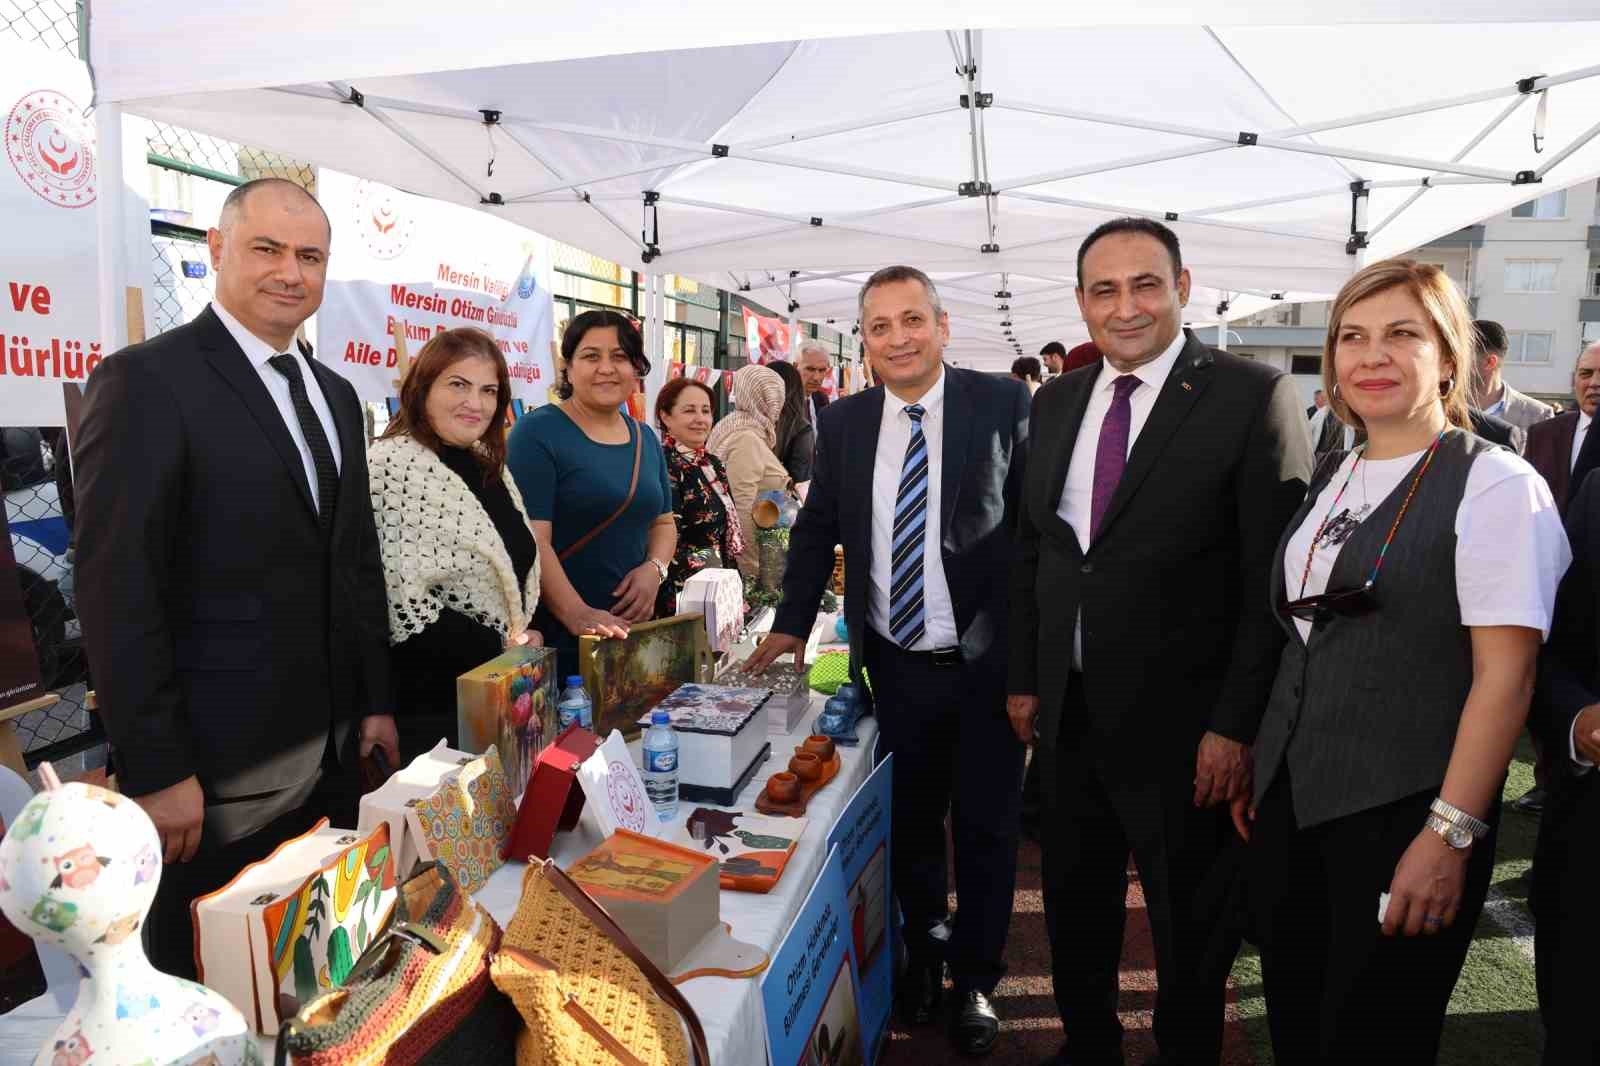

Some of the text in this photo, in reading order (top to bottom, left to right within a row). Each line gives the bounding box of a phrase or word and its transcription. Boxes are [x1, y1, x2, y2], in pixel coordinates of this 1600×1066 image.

[437, 263, 480, 289] Mersin
[9, 281, 52, 315] ve
[391, 284, 447, 314] Mersin
[450, 298, 485, 322] Otizm
[386, 315, 431, 341] Bkım
[343, 341, 382, 367] Aile
[787, 953, 807, 995] Otizm
